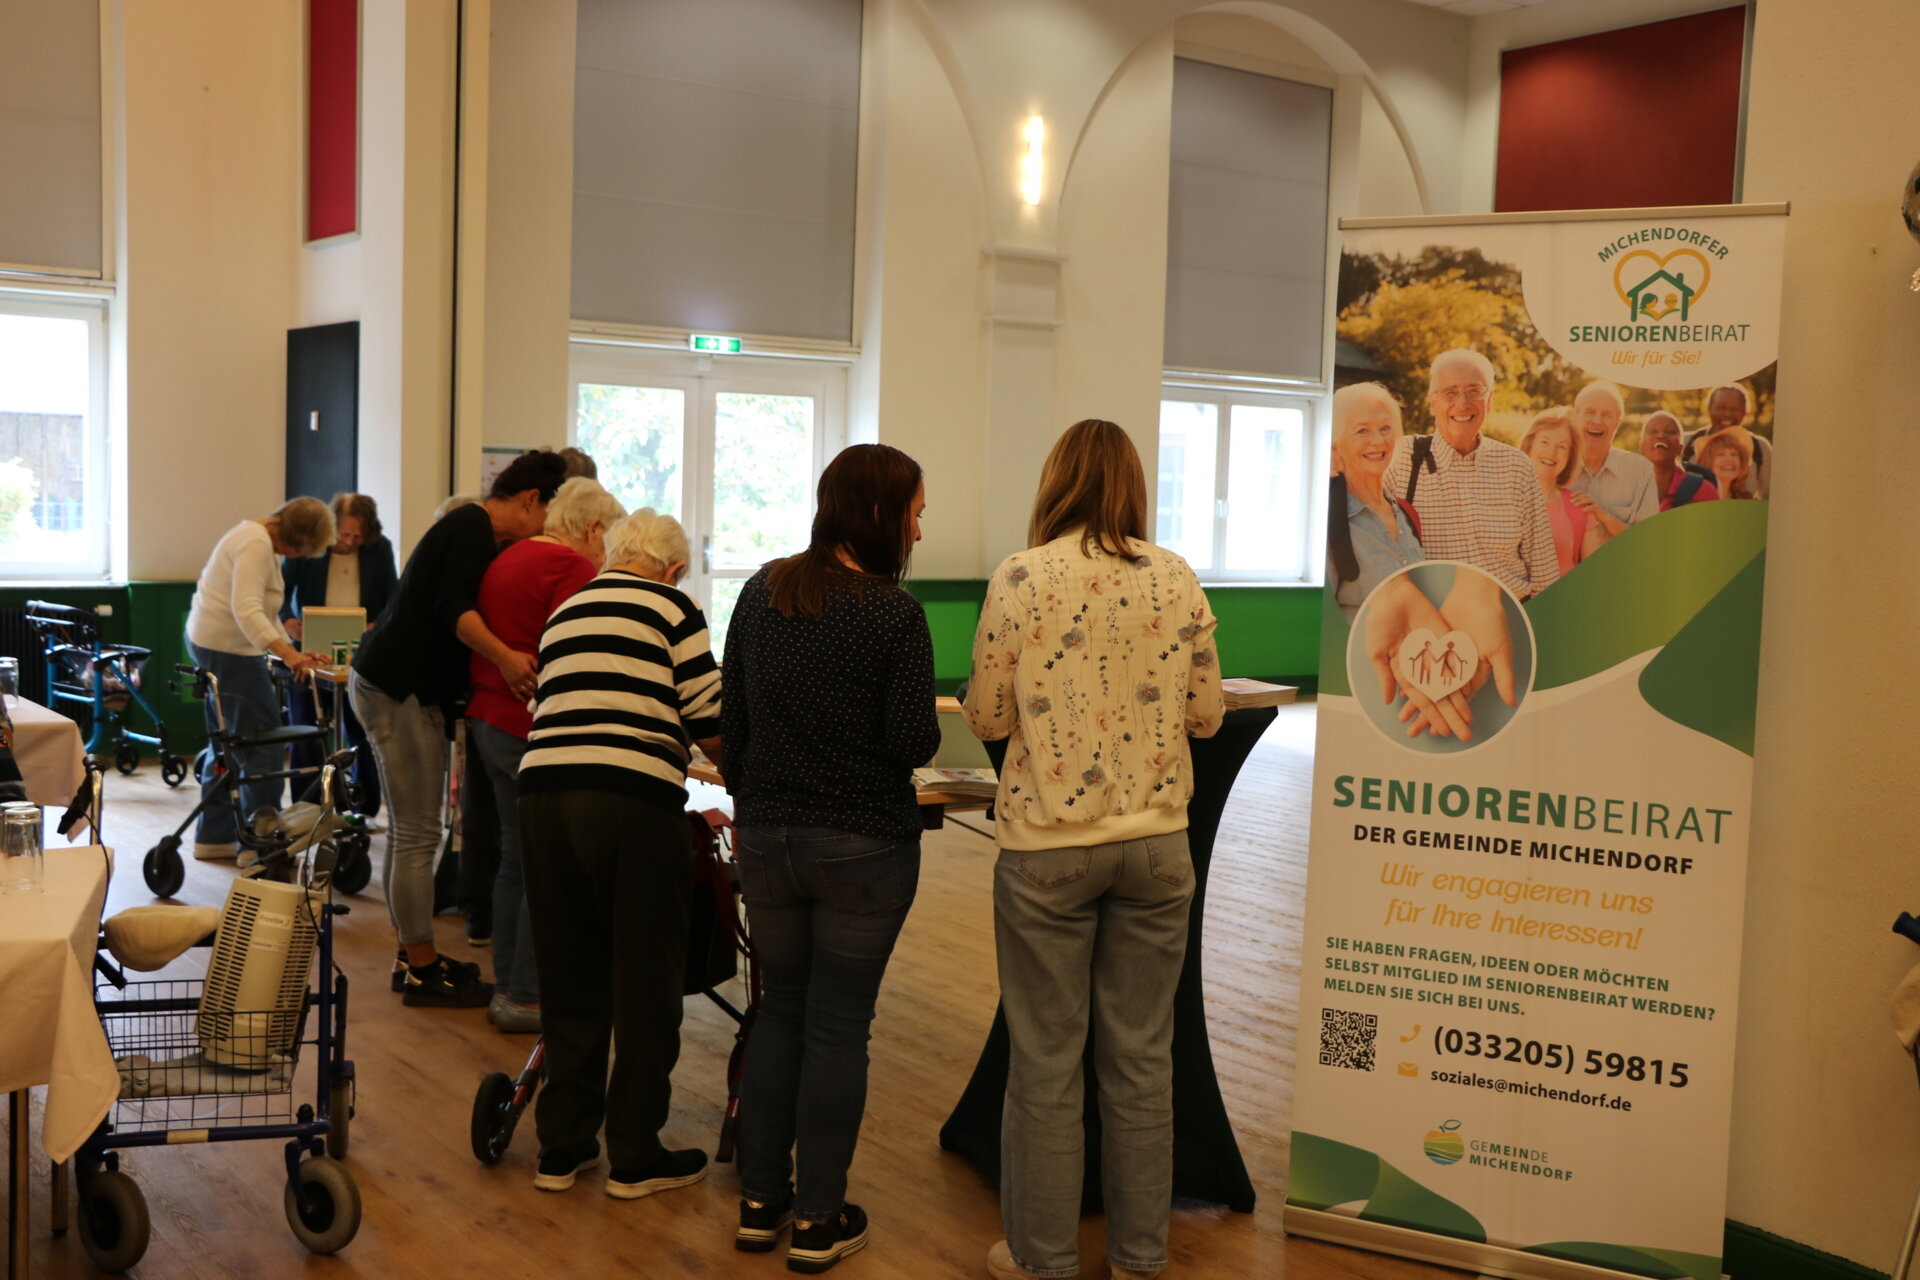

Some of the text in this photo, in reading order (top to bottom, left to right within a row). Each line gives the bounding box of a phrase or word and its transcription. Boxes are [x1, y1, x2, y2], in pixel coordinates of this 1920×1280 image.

[1597, 227, 1729, 263] MICHENDORFER
[1569, 324, 1750, 343] SENIORENBEIRAT
[1611, 350, 1703, 368] Wir für Sie!
[1333, 774, 1732, 844] SENIORENBEIRAT
[1353, 825, 1694, 876] DER GEMEINDE MICHENDORF
[1380, 862, 1655, 915] Wir engagieren uns
[1383, 898, 1644, 951] für Ihre Interessen!
[1326, 936, 1669, 992] SIE HABEN FRAGEN, IDEEN ODER MÖCHTEN
[1324, 977, 1525, 1016] MELDEN SIE SICH BEI UNS.
[1325, 957, 1715, 1021] SELBST MITGLIED IM SENIORENBEIRAT WERDEN?
[1434, 1026, 1689, 1088] (033205) 59815
[1431, 1069, 1632, 1111] soziales@michendorf.de
[1469, 1154, 1573, 1182] MICHENDORF
[1470, 1139, 1550, 1163] GEMEINDE
